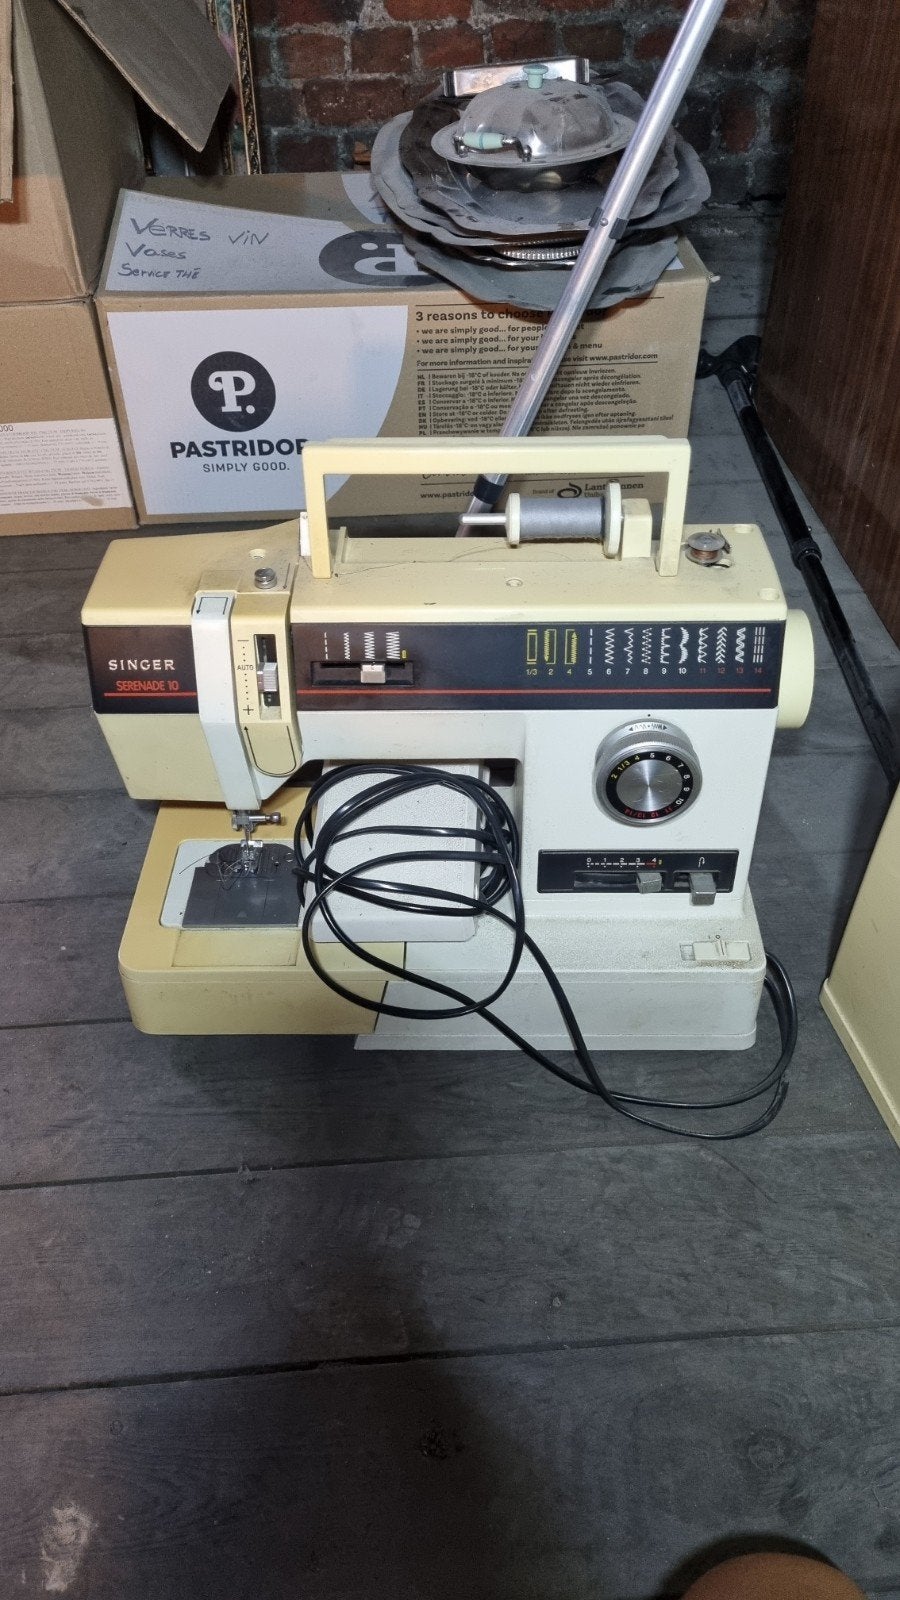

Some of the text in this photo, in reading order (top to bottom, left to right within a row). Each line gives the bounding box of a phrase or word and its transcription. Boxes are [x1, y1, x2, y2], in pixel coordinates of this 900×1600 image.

[415, 311, 424, 322] 3
[427, 311, 478, 321] reasons
[480, 309, 495, 320] to
[497, 308, 544, 319] choose
[450, 326, 477, 336] simply
[507, 324, 520, 332] for
[450, 336, 477, 346] simply
[507, 334, 520, 342] for
[520, 335, 540, 344] your
[450, 345, 477, 355] simply
[507, 344, 520, 352] for
[429, 359, 447, 367] more
[449, 358, 492, 366] information
[492, 357, 507, 365] and
[507, 356, 532, 366] inspira
[589, 353, 658, 362] www.pastridor.com
[203, 461, 290, 473] SIMPLY GOOD.
[108, 658, 176, 671] SINGER
[526, 668, 538, 676] 1/3
[548, 668, 554, 676] 2
[566, 668, 572, 676] 4
[587, 668, 593, 676] 5
[606, 668, 612, 676] 6
[625, 668, 631, 676] 7
[643, 668, 649, 676] 8
[661, 668, 667, 676] 9
[678, 668, 687, 676] 10
[116, 680, 180, 691] SERENADE 10
[617, 760, 631, 771] 1/3
